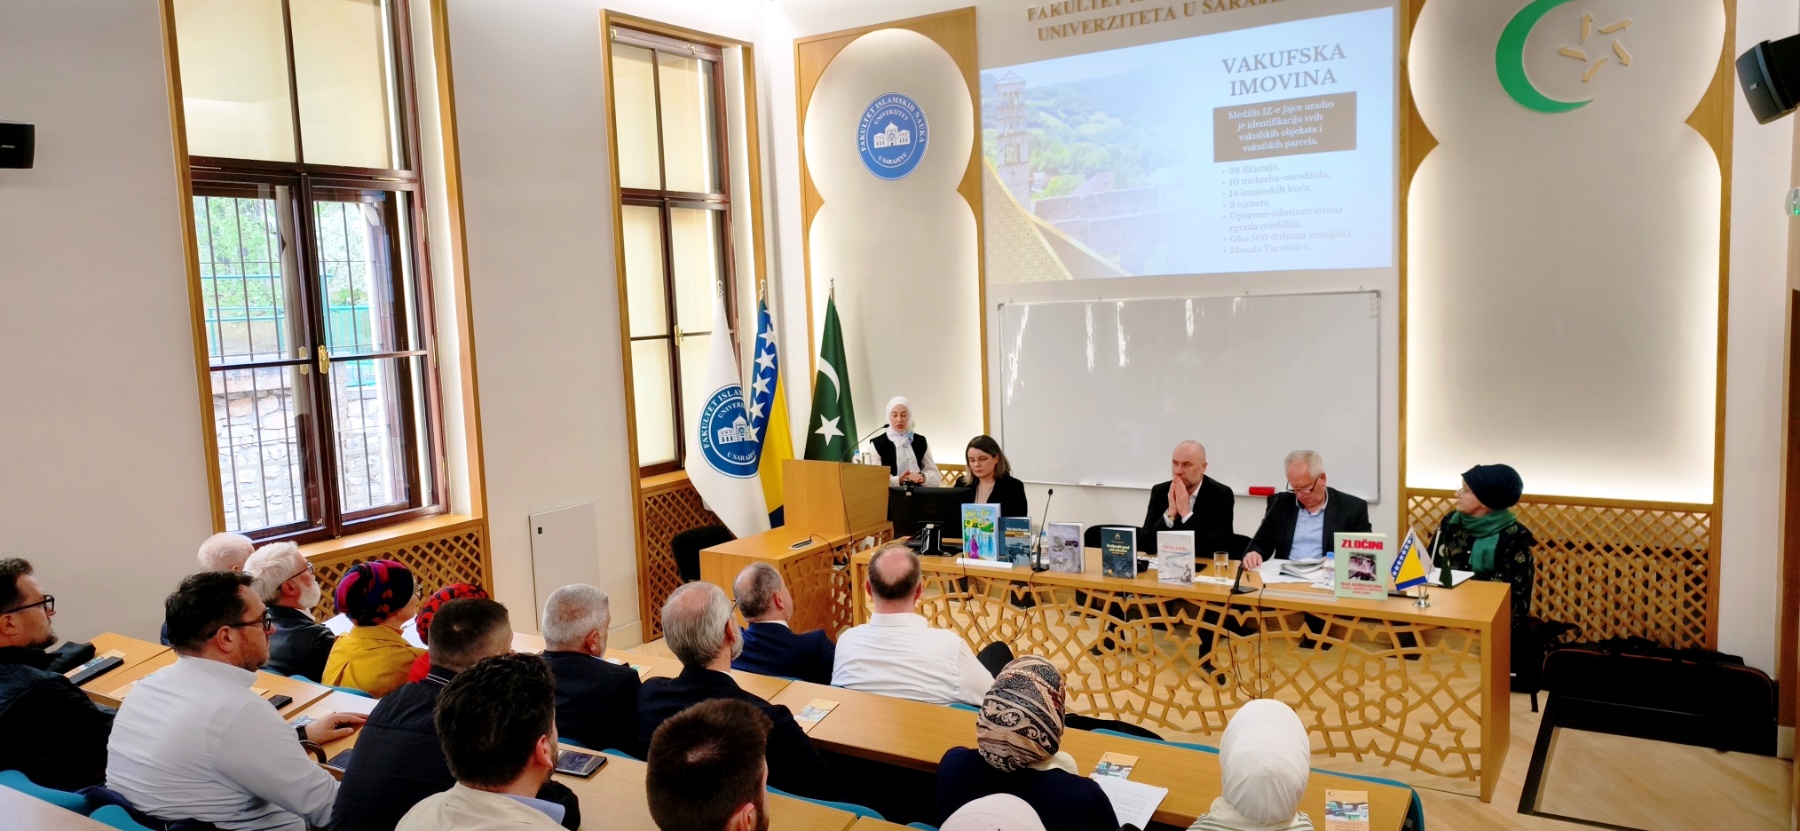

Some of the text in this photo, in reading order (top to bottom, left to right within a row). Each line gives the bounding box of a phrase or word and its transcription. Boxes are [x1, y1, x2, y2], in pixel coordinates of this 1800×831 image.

[1038, 0, 1280, 41] UNIVERZITETA U SARA
[1221, 43, 1347, 74] VAKUFSKA
[1230, 68, 1338, 96] IMOVINA
[874, 109, 909, 125] UNIVERZITET
[1228, 110, 1261, 120] Medžlis
[1282, 103, 1303, 115] Jajce
[1304, 99, 1334, 110] uradio
[860, 96, 926, 152] FAKULTET ISLAMSKIH NAUKA
[1237, 113, 1323, 132] je identifikaciju svih
[1239, 130, 1279, 141] vakufskih
[1281, 125, 1317, 137] objekata
[1242, 137, 1318, 152] vakufskih parcela.
[1228, 166, 1240, 174] 39
[1229, 178, 1239, 186] 10
[1240, 185, 1285, 197] imamskih
[1229, 201, 1235, 209] 3
[1229, 222, 1258, 233] zgrada
[1230, 235, 1249, 243] Oko
[1250, 233, 1269, 242] 500
[1270, 231, 1306, 240] duluma
[1230, 245, 1262, 254] Musala
[701, 400, 718, 449] FAKULTET
[1341, 539, 1384, 551] ZLOČINI
